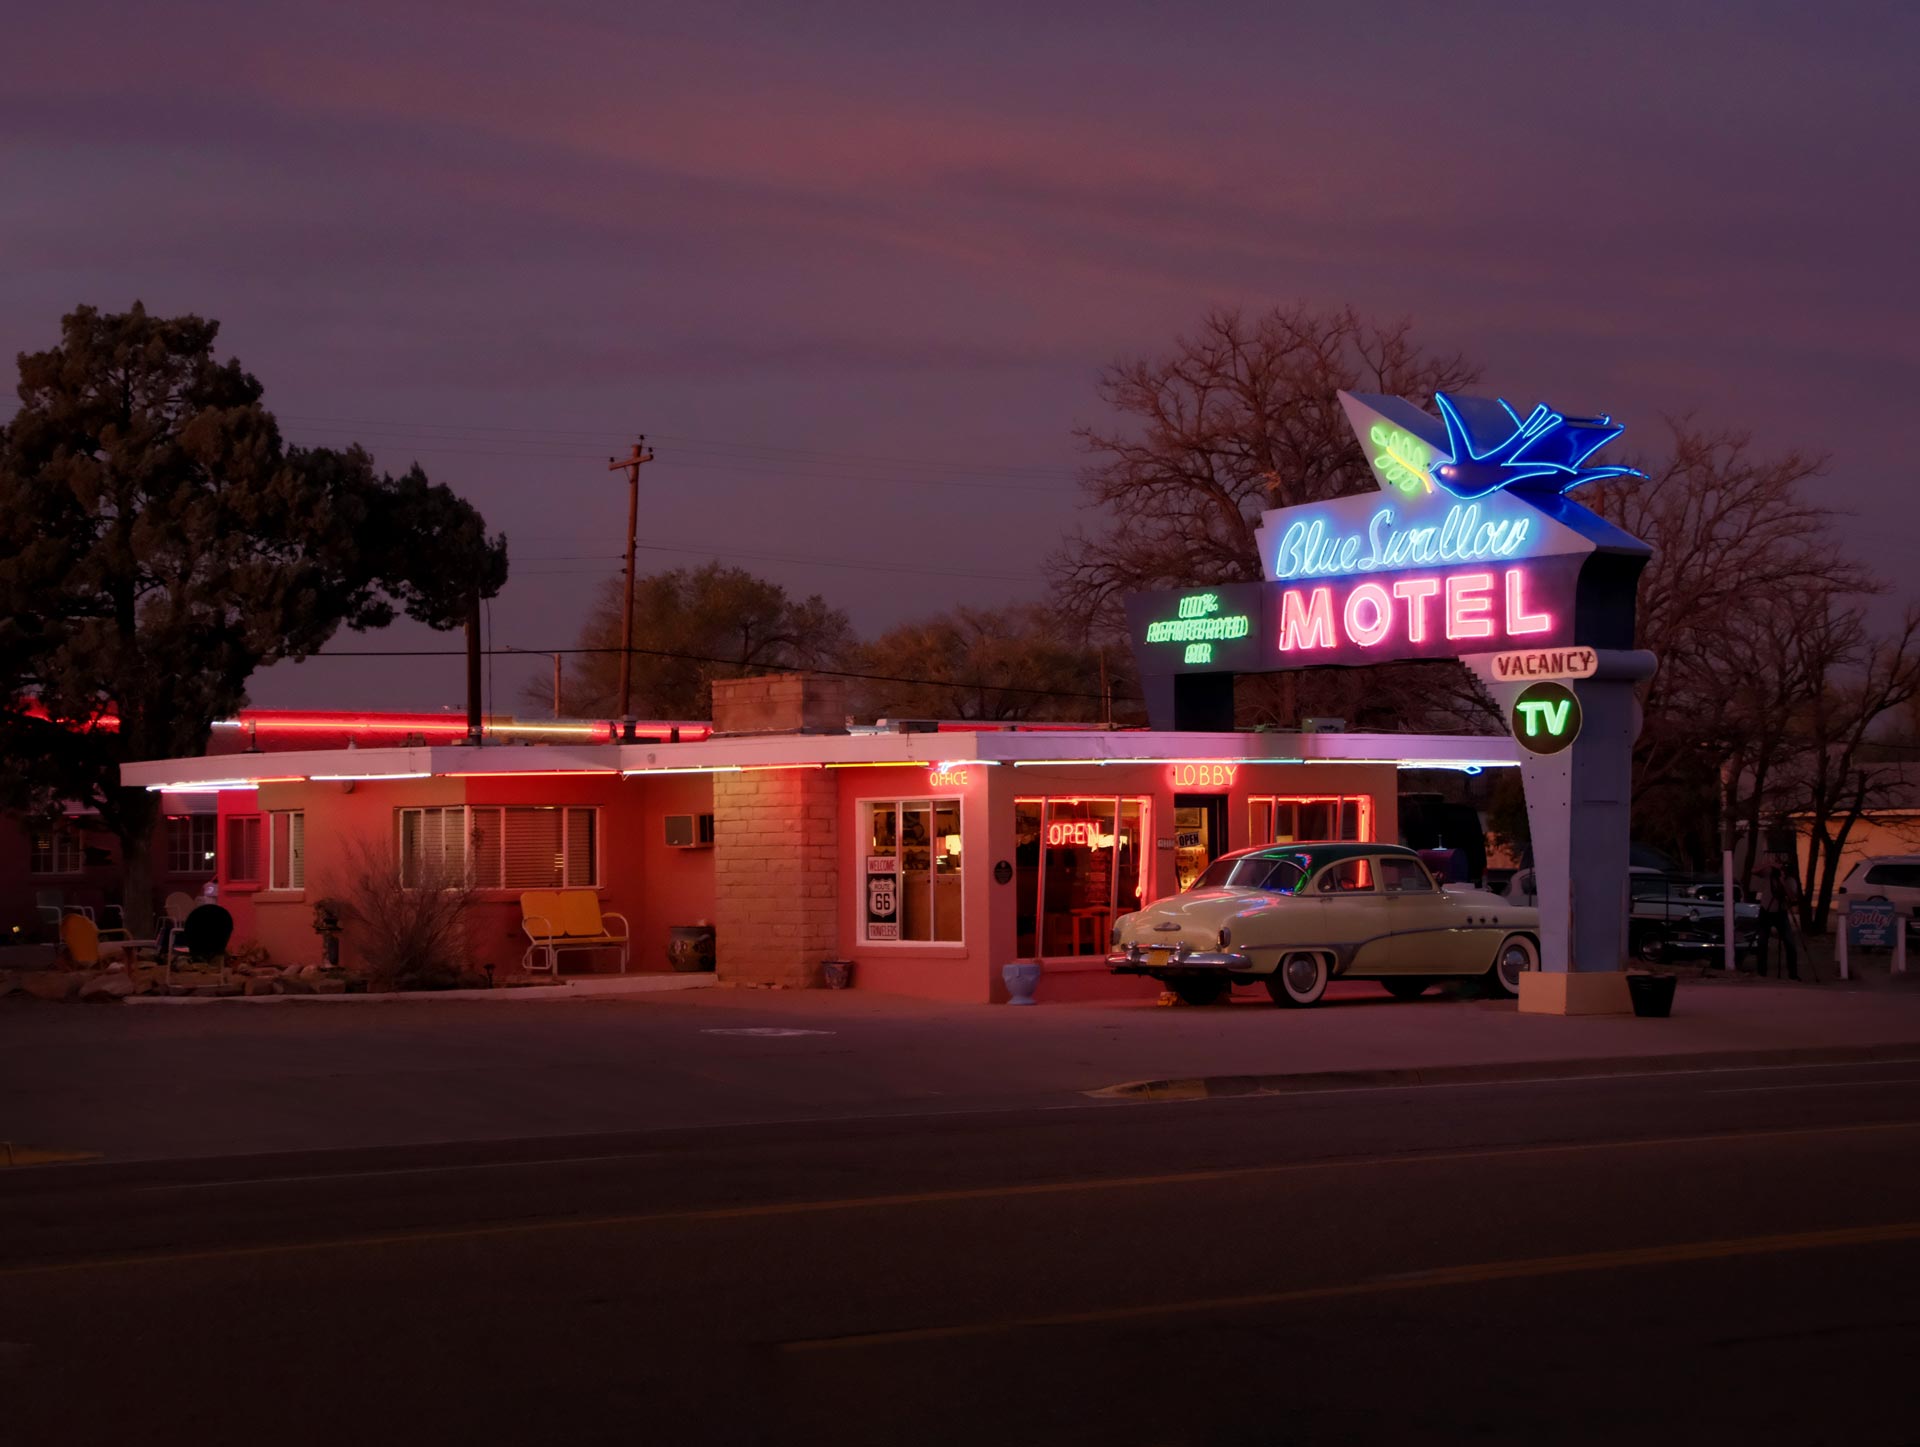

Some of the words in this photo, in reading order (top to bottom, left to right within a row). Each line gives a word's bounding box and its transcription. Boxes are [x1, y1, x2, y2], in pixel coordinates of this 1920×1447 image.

[1275, 519, 1361, 578] Blue
[1357, 503, 1531, 571] Swallow
[1278, 569, 1550, 651] MOTEL
[1497, 650, 1594, 676] VACANCY
[1515, 699, 1571, 737] TV
[929, 770, 968, 787] OFFICE
[1174, 764, 1237, 786] LOBBY
[1049, 822, 1100, 846] OPEN
[1178, 832, 1200, 847] OPEN
[869, 860, 896, 872] WELCOME
[875, 893, 891, 910] 66
[870, 925, 897, 937] TRAVELERS
